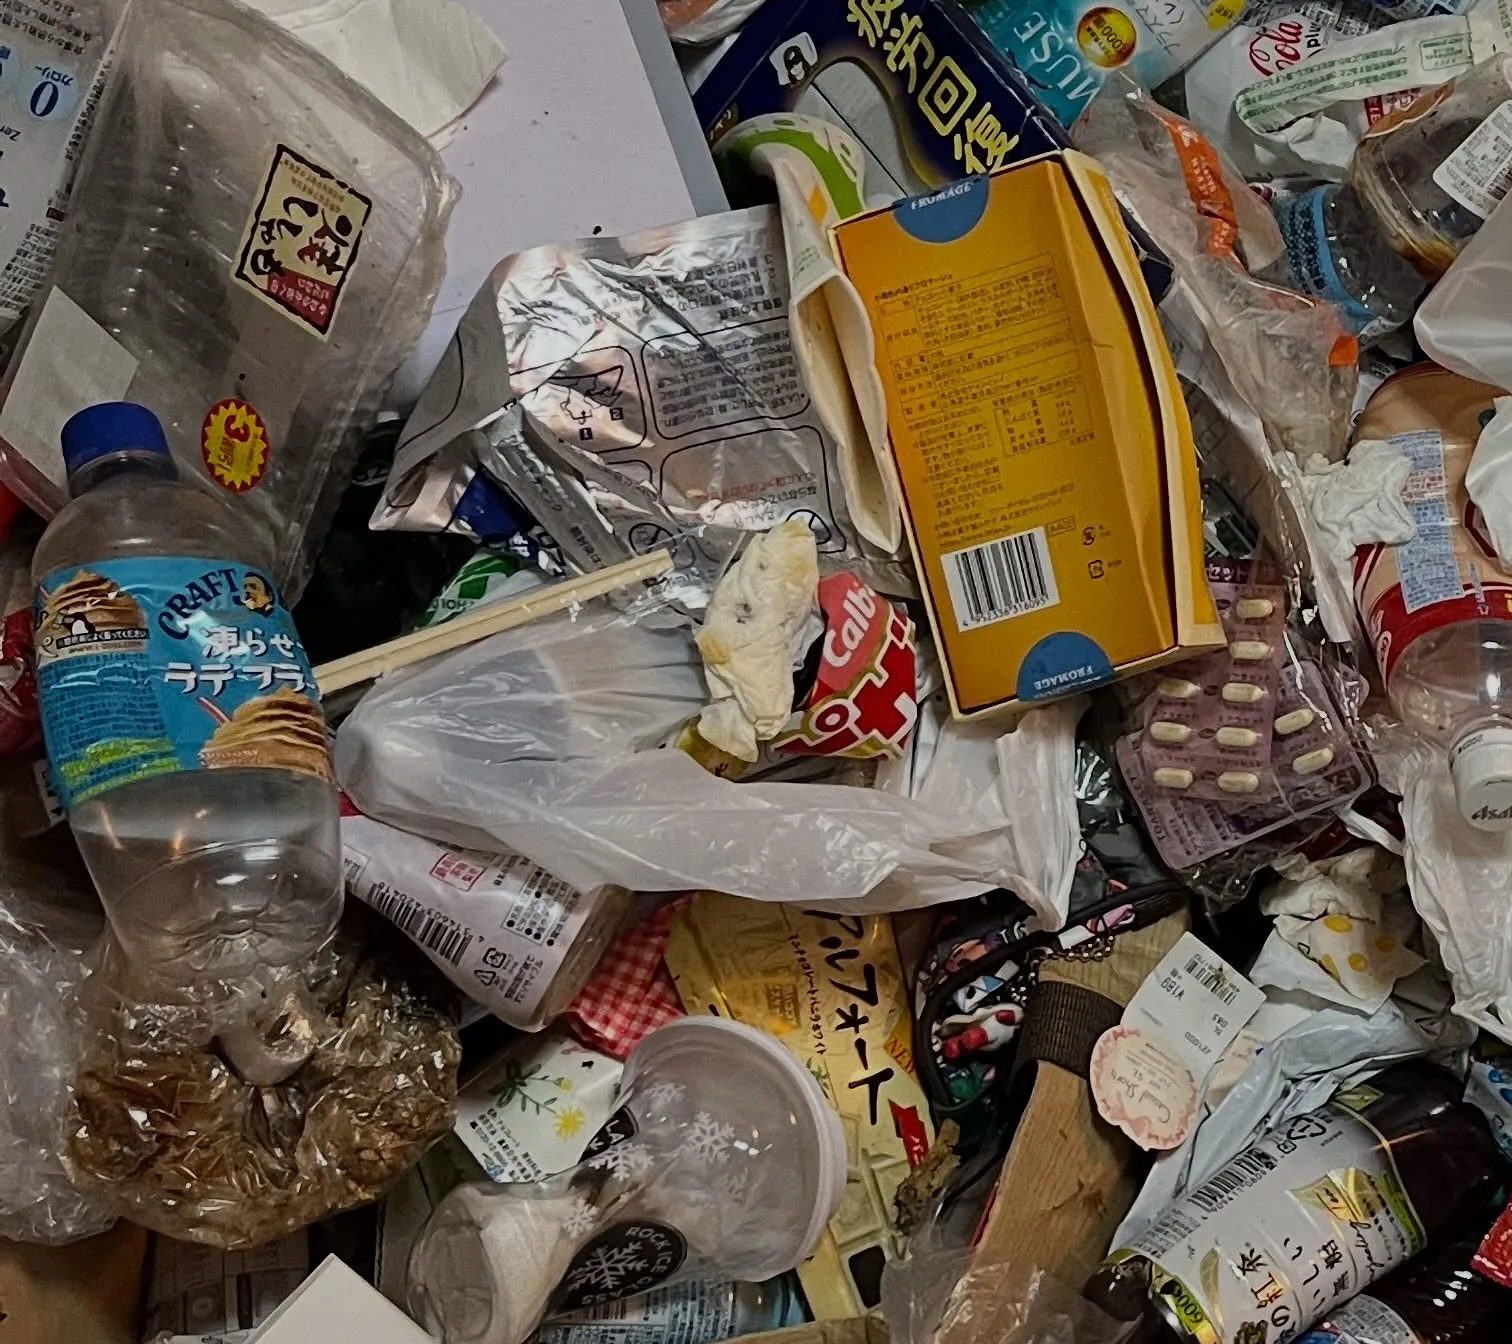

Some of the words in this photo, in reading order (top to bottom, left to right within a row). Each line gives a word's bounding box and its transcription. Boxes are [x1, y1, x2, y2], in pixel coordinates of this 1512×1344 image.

[26, 78, 60, 118] 0
[156, 567, 242, 642] CRAFT
[1032, 664, 1093, 690] FROMAGE
